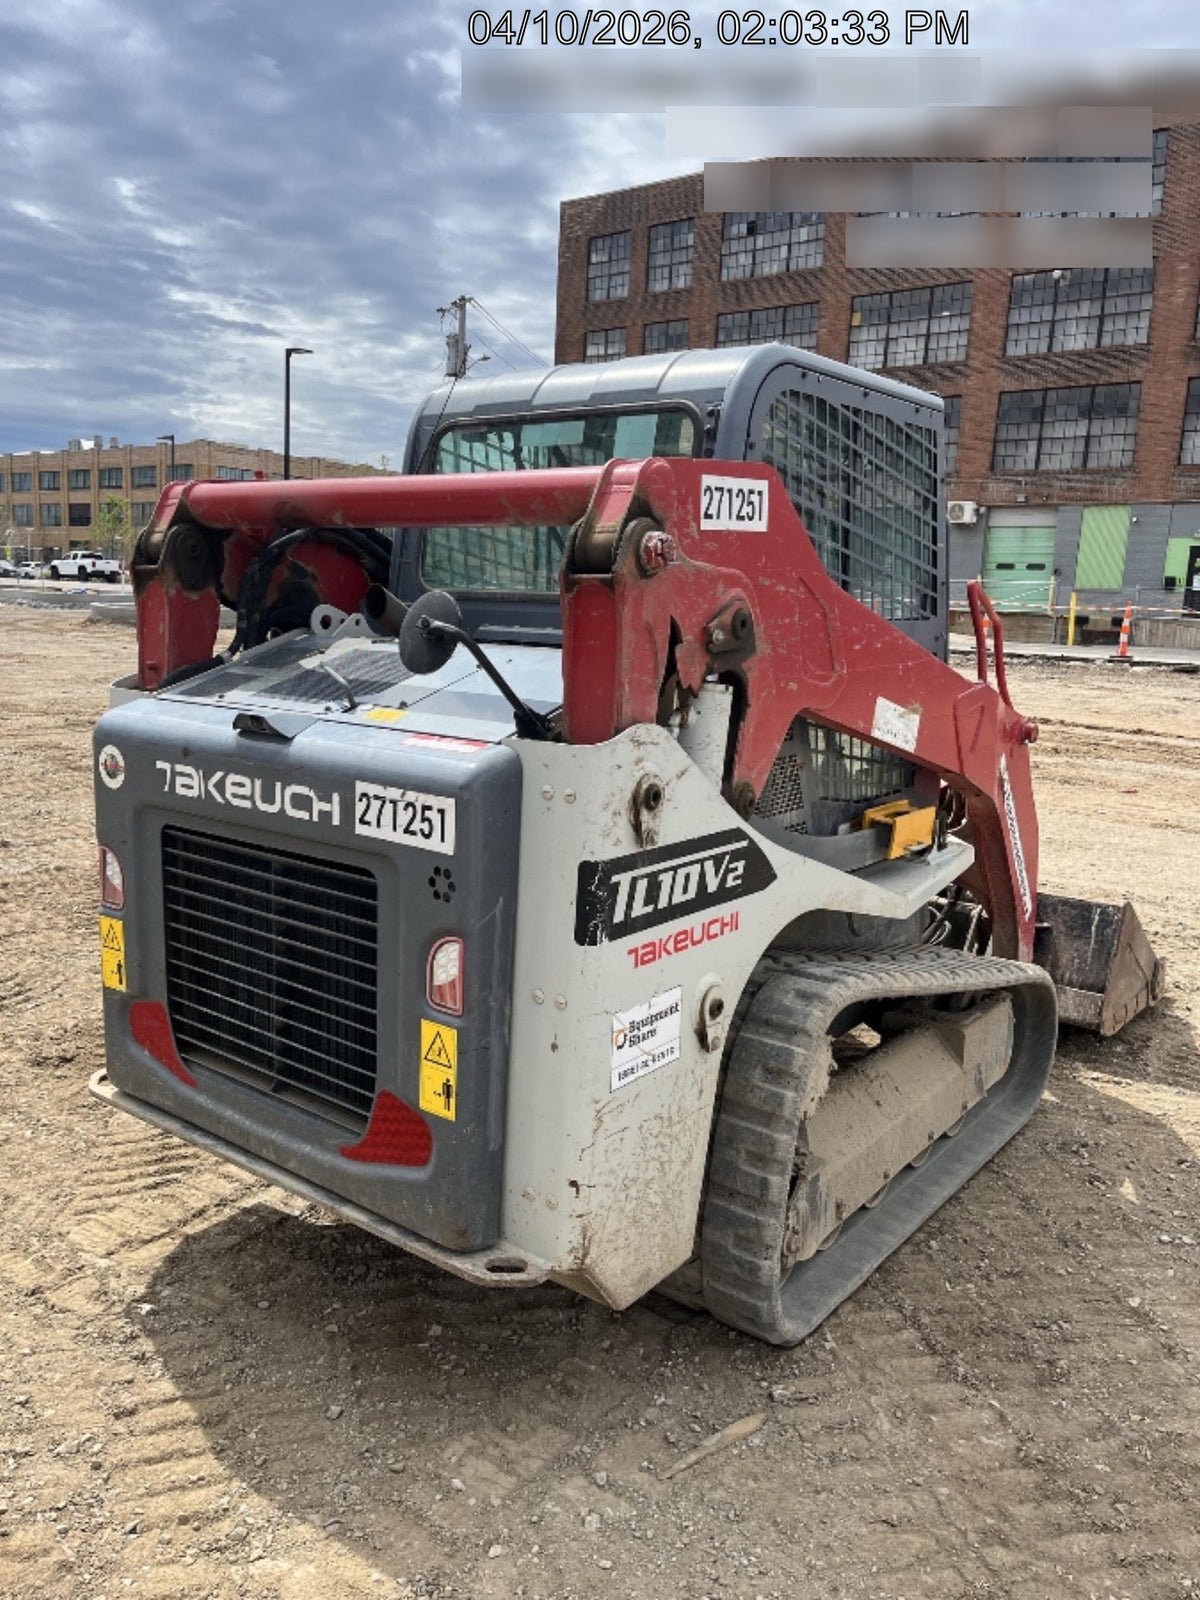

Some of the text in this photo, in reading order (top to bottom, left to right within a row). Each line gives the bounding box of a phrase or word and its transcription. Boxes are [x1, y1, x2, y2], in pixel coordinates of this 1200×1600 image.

[703, 485, 763, 521] 271251
[358, 792, 446, 843] 271251
[609, 854, 746, 924] TL10V2
